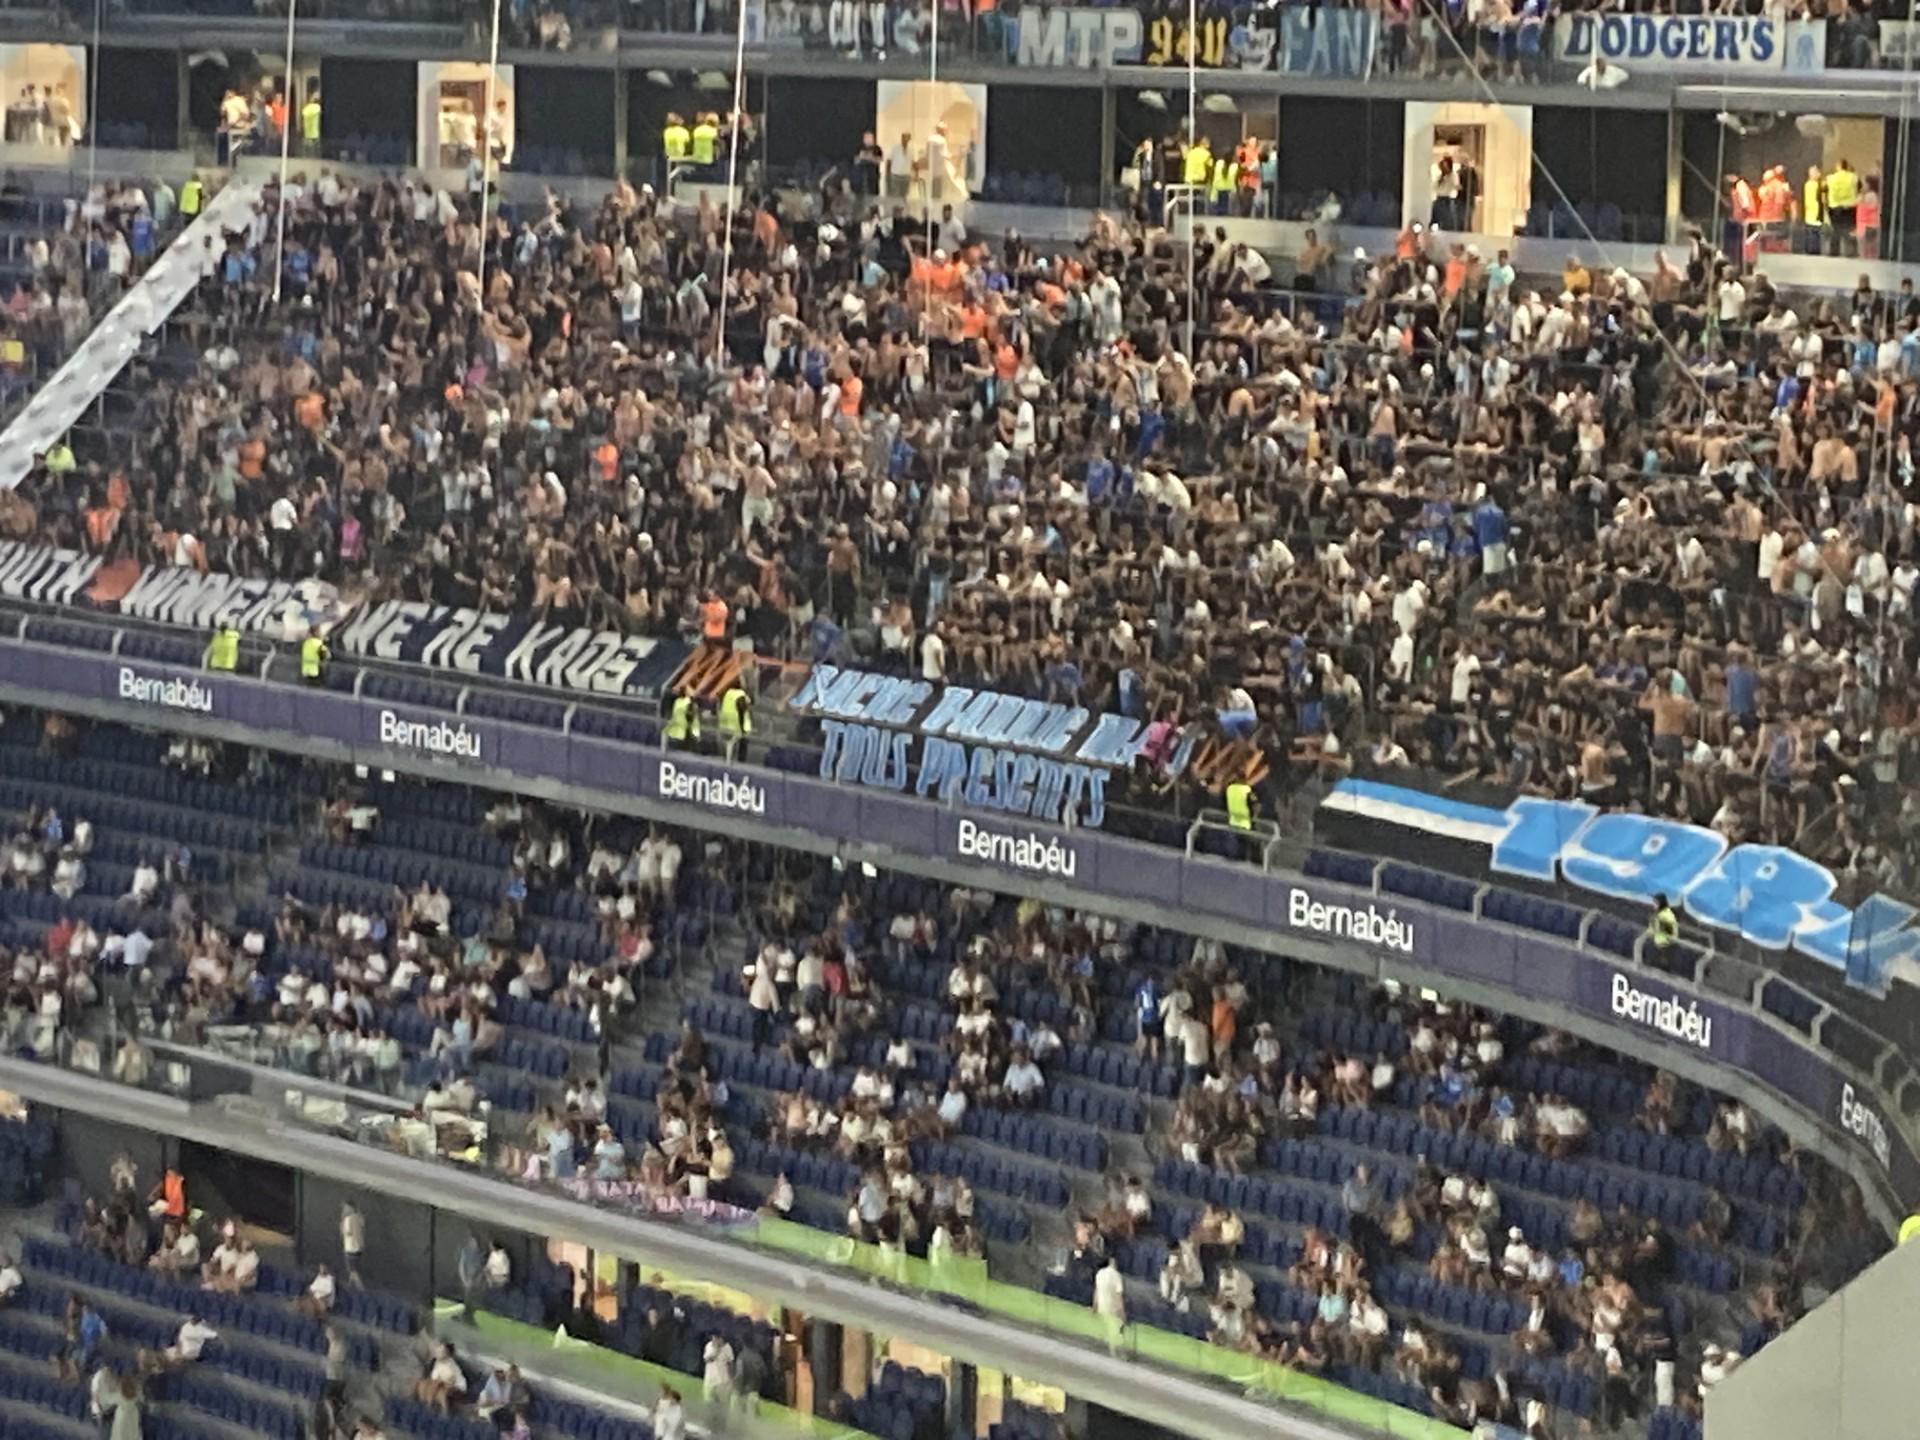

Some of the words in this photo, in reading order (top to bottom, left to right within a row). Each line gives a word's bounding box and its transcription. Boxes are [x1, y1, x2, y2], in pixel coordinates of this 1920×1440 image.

[1018, 8, 1143, 67] MTP
[1564, 15, 1776, 61] DODGER'S
[342, 599, 510, 673] WE'RE
[119, 667, 212, 711] Bernabéu
[381, 710, 480, 758] Bernabéu
[660, 761, 766, 815] Bernabéu
[958, 819, 1075, 877] Bernabéu
[1289, 887, 1413, 953] Bernabéu
[1612, 972, 1711, 1047] Bernabéu
